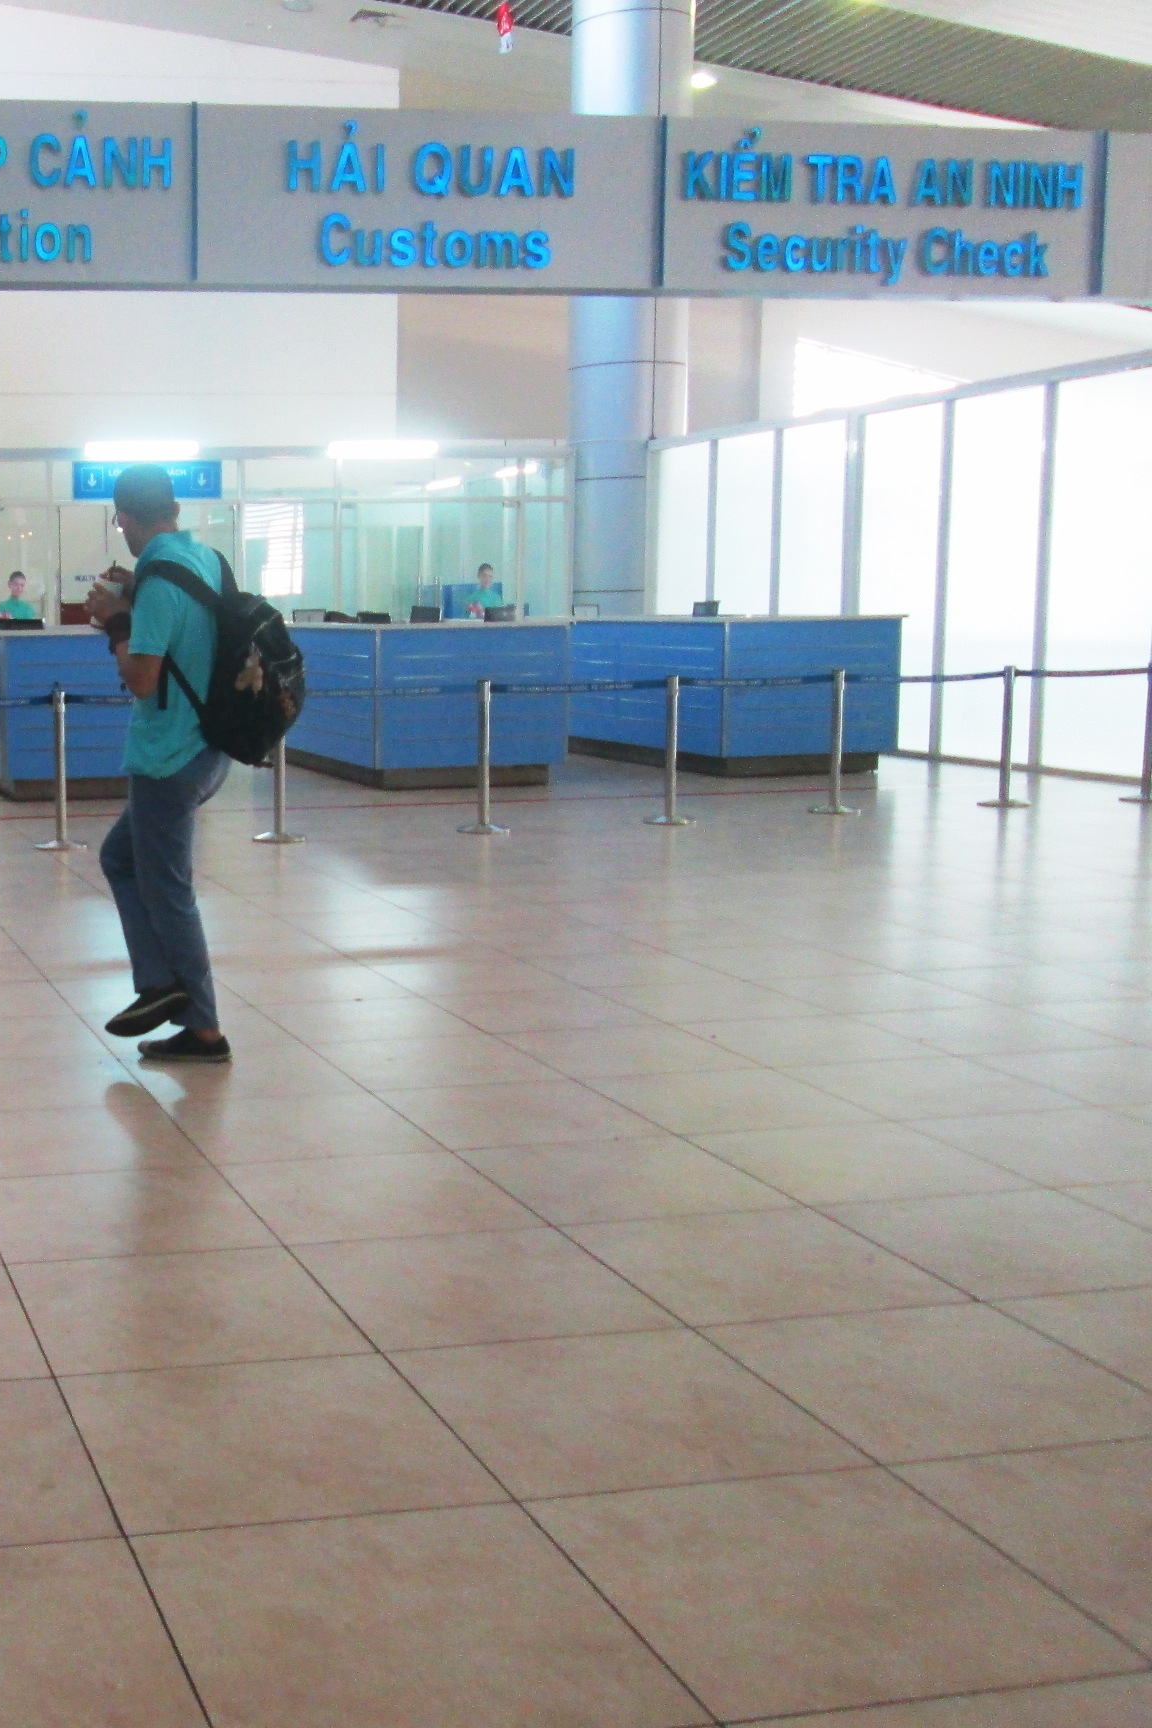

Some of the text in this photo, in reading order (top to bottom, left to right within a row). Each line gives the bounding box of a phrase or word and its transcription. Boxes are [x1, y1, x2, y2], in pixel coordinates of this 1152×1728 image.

[27, 108, 175, 190] CẢNH
[285, 119, 576, 198] HẢI QUAN
[681, 126, 1086, 211] KIỂM TRA AN NINH
[318, 211, 554, 271] Customs
[723, 221, 1050, 287] Security Check
